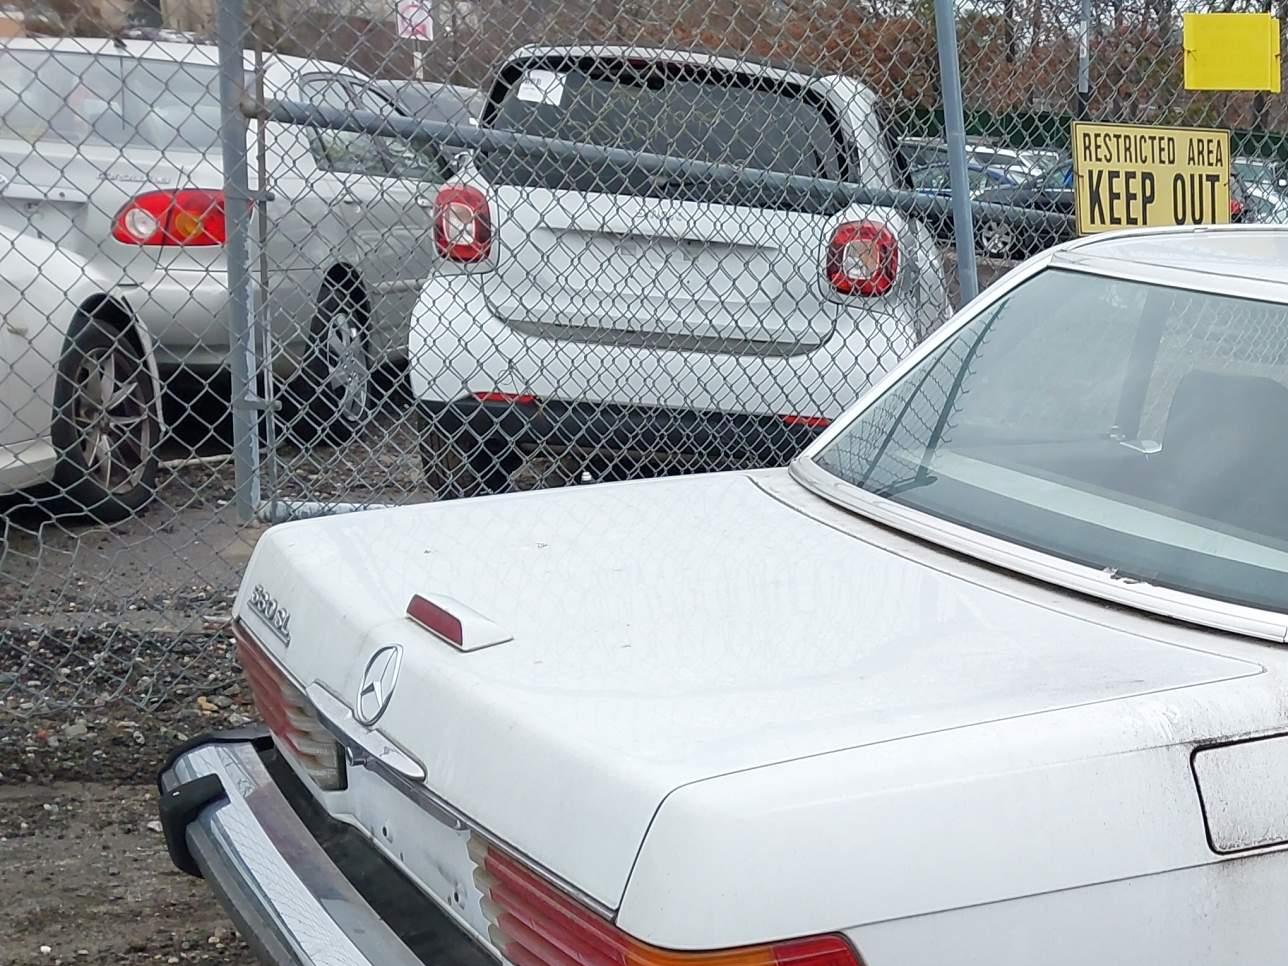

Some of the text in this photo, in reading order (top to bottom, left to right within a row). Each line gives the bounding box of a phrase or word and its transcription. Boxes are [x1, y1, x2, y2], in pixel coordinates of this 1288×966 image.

[1083, 132, 1223, 167] RESTRICTED AREA
[1088, 169, 1220, 226] KEEP OUT
